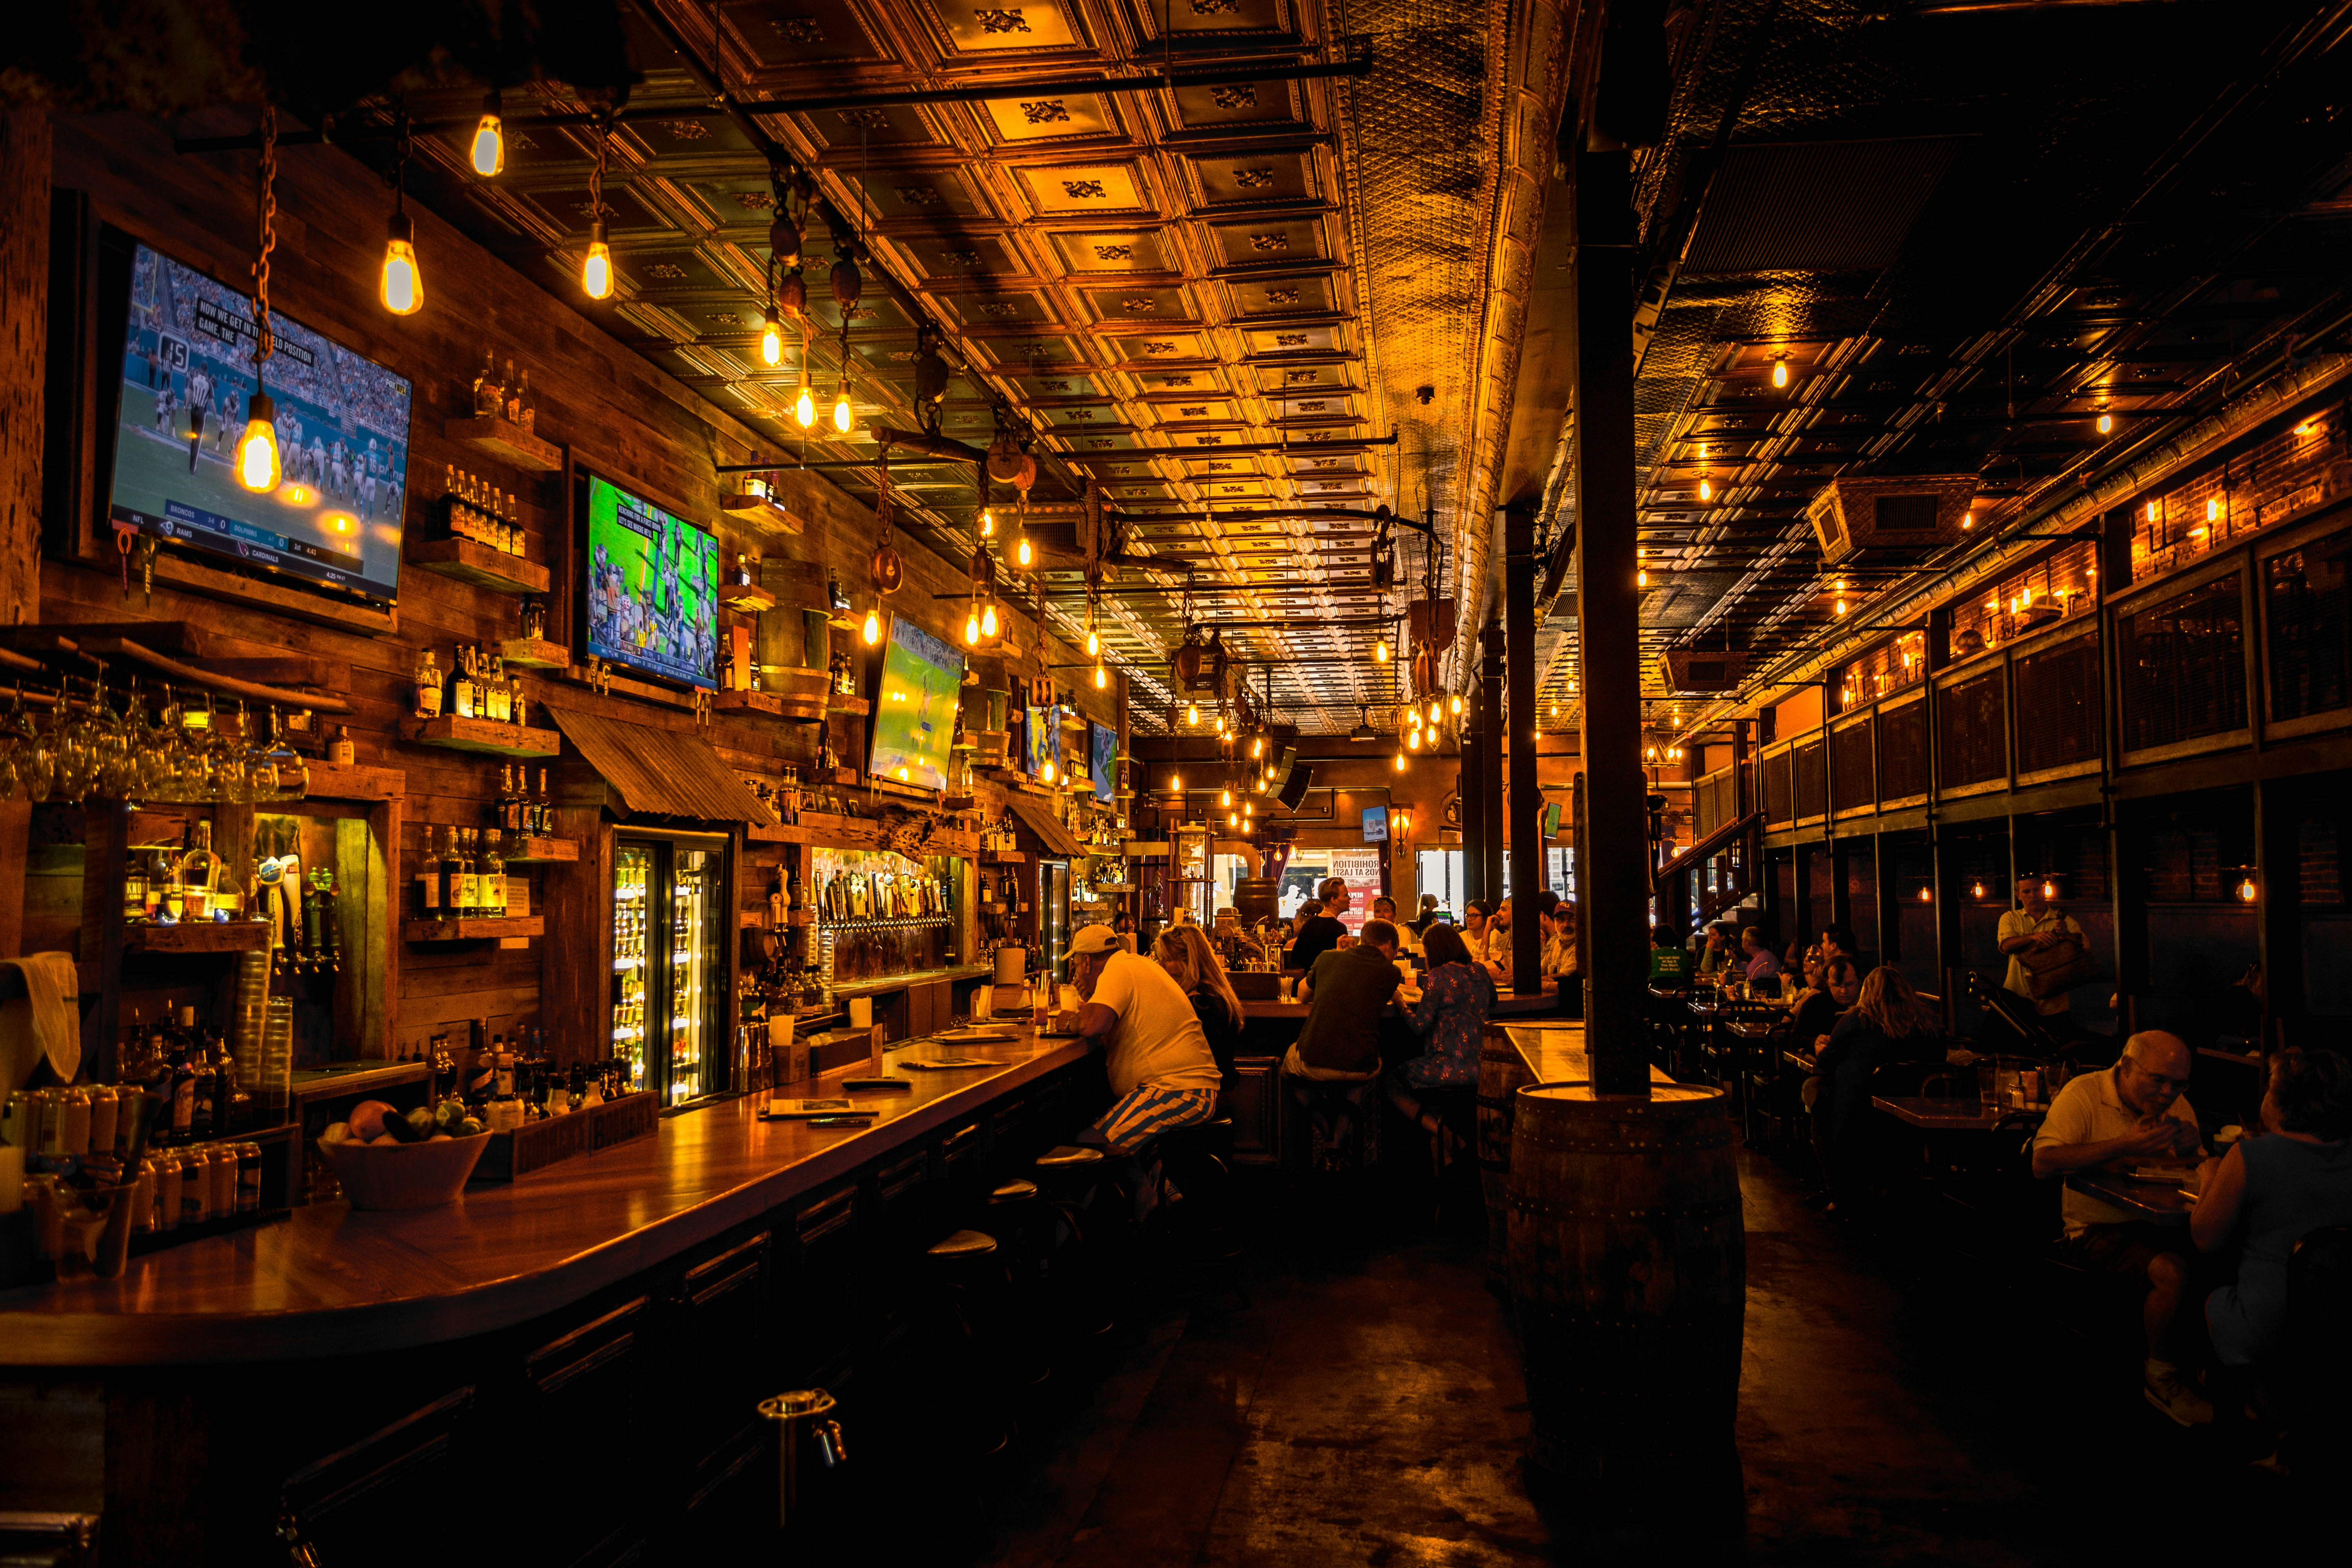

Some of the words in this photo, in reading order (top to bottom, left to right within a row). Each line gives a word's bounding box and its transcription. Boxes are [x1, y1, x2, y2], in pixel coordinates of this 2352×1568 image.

[199, 318, 220, 338] GAME,
[221, 328, 234, 343] THE
[201, 301, 217, 317] NOW
[218, 310, 228, 323] WE
[230, 316, 243, 330] GET
[244, 322, 252, 335] IN
[284, 340, 312, 364] POSITION
[386, 378, 396, 389] FOX
[396, 383, 406, 395] NFL
[133, 515, 144, 524] NFL
[171, 505, 195, 518] BRONCOS
[221, 520, 226, 529] 0
[618, 505, 634, 519] REACHING
[643, 517, 652, 527] FIRST
[177, 528, 192, 538] RAMS
[234, 524, 258, 538] DOLPHINS
[279, 538, 284, 547] 0
[633, 523, 644, 534] WHERE
[252, 550, 279, 563] CARDINALS
[307, 548, 316, 556] 4:41
[326, 571, 336, 579] 4:25
